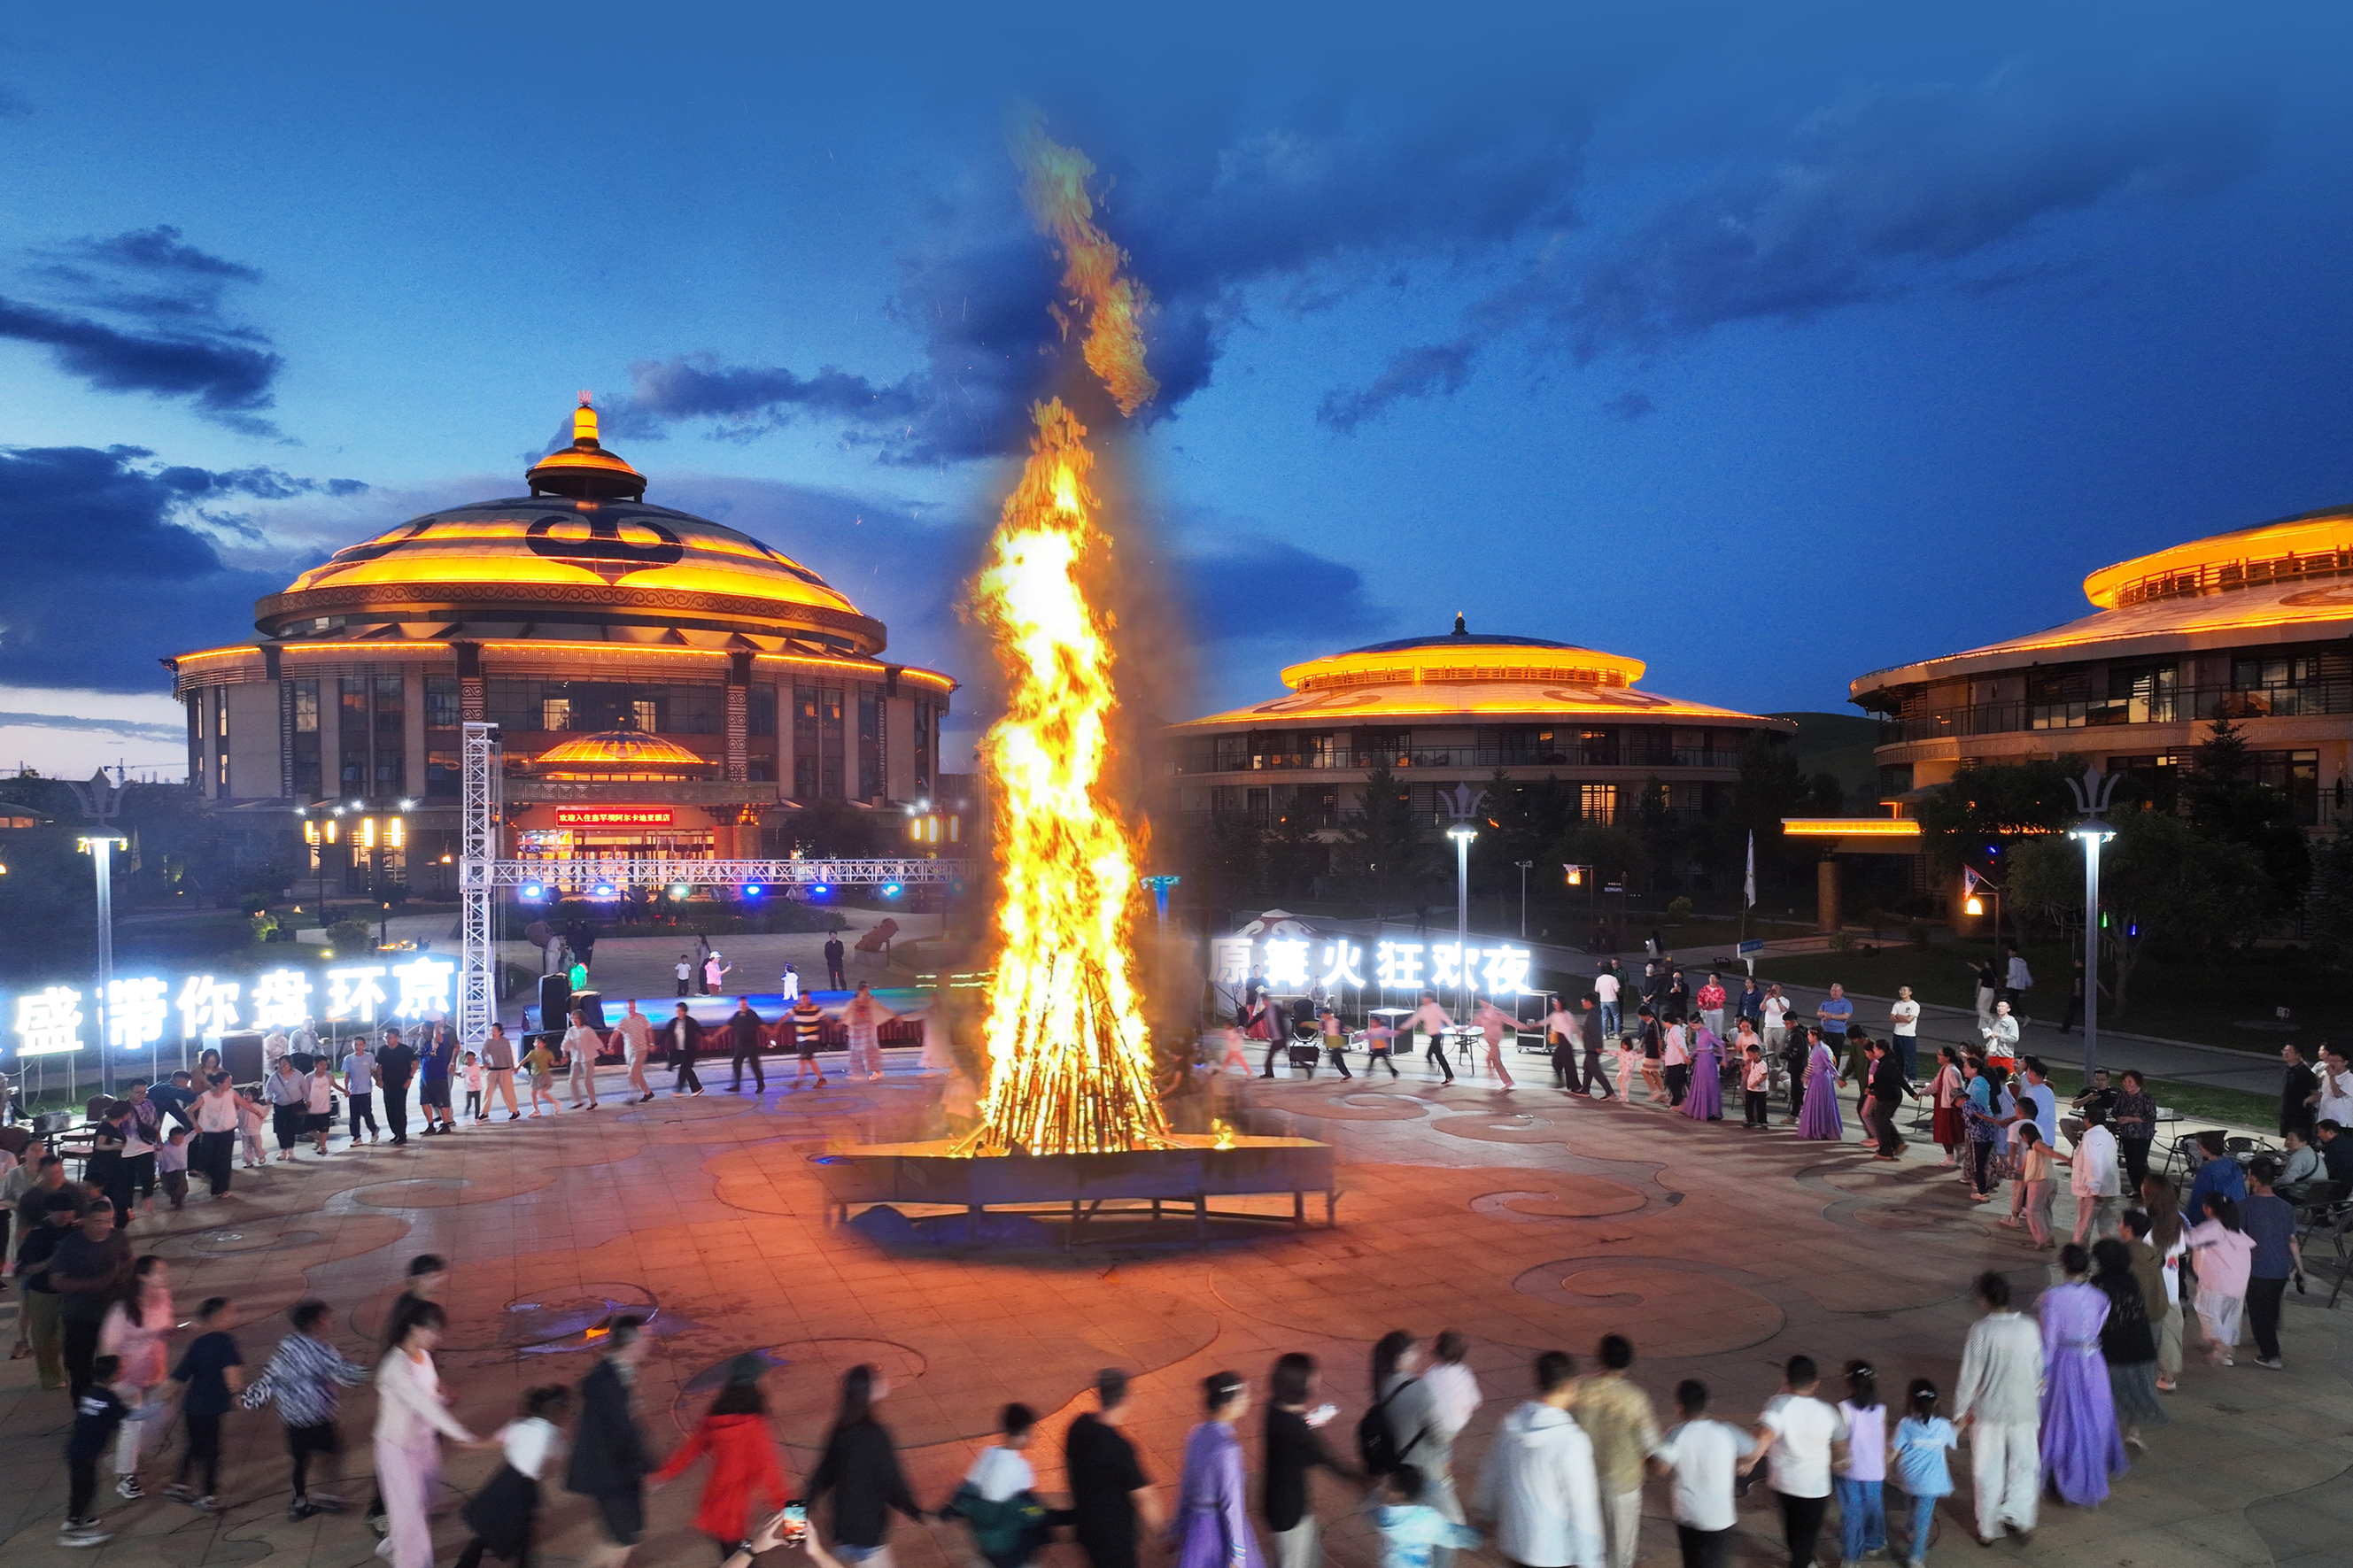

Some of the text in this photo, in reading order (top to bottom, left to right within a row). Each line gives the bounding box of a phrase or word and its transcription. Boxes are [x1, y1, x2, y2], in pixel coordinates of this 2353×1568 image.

[0, 956, 454, 1057] 盛带你盘环京
